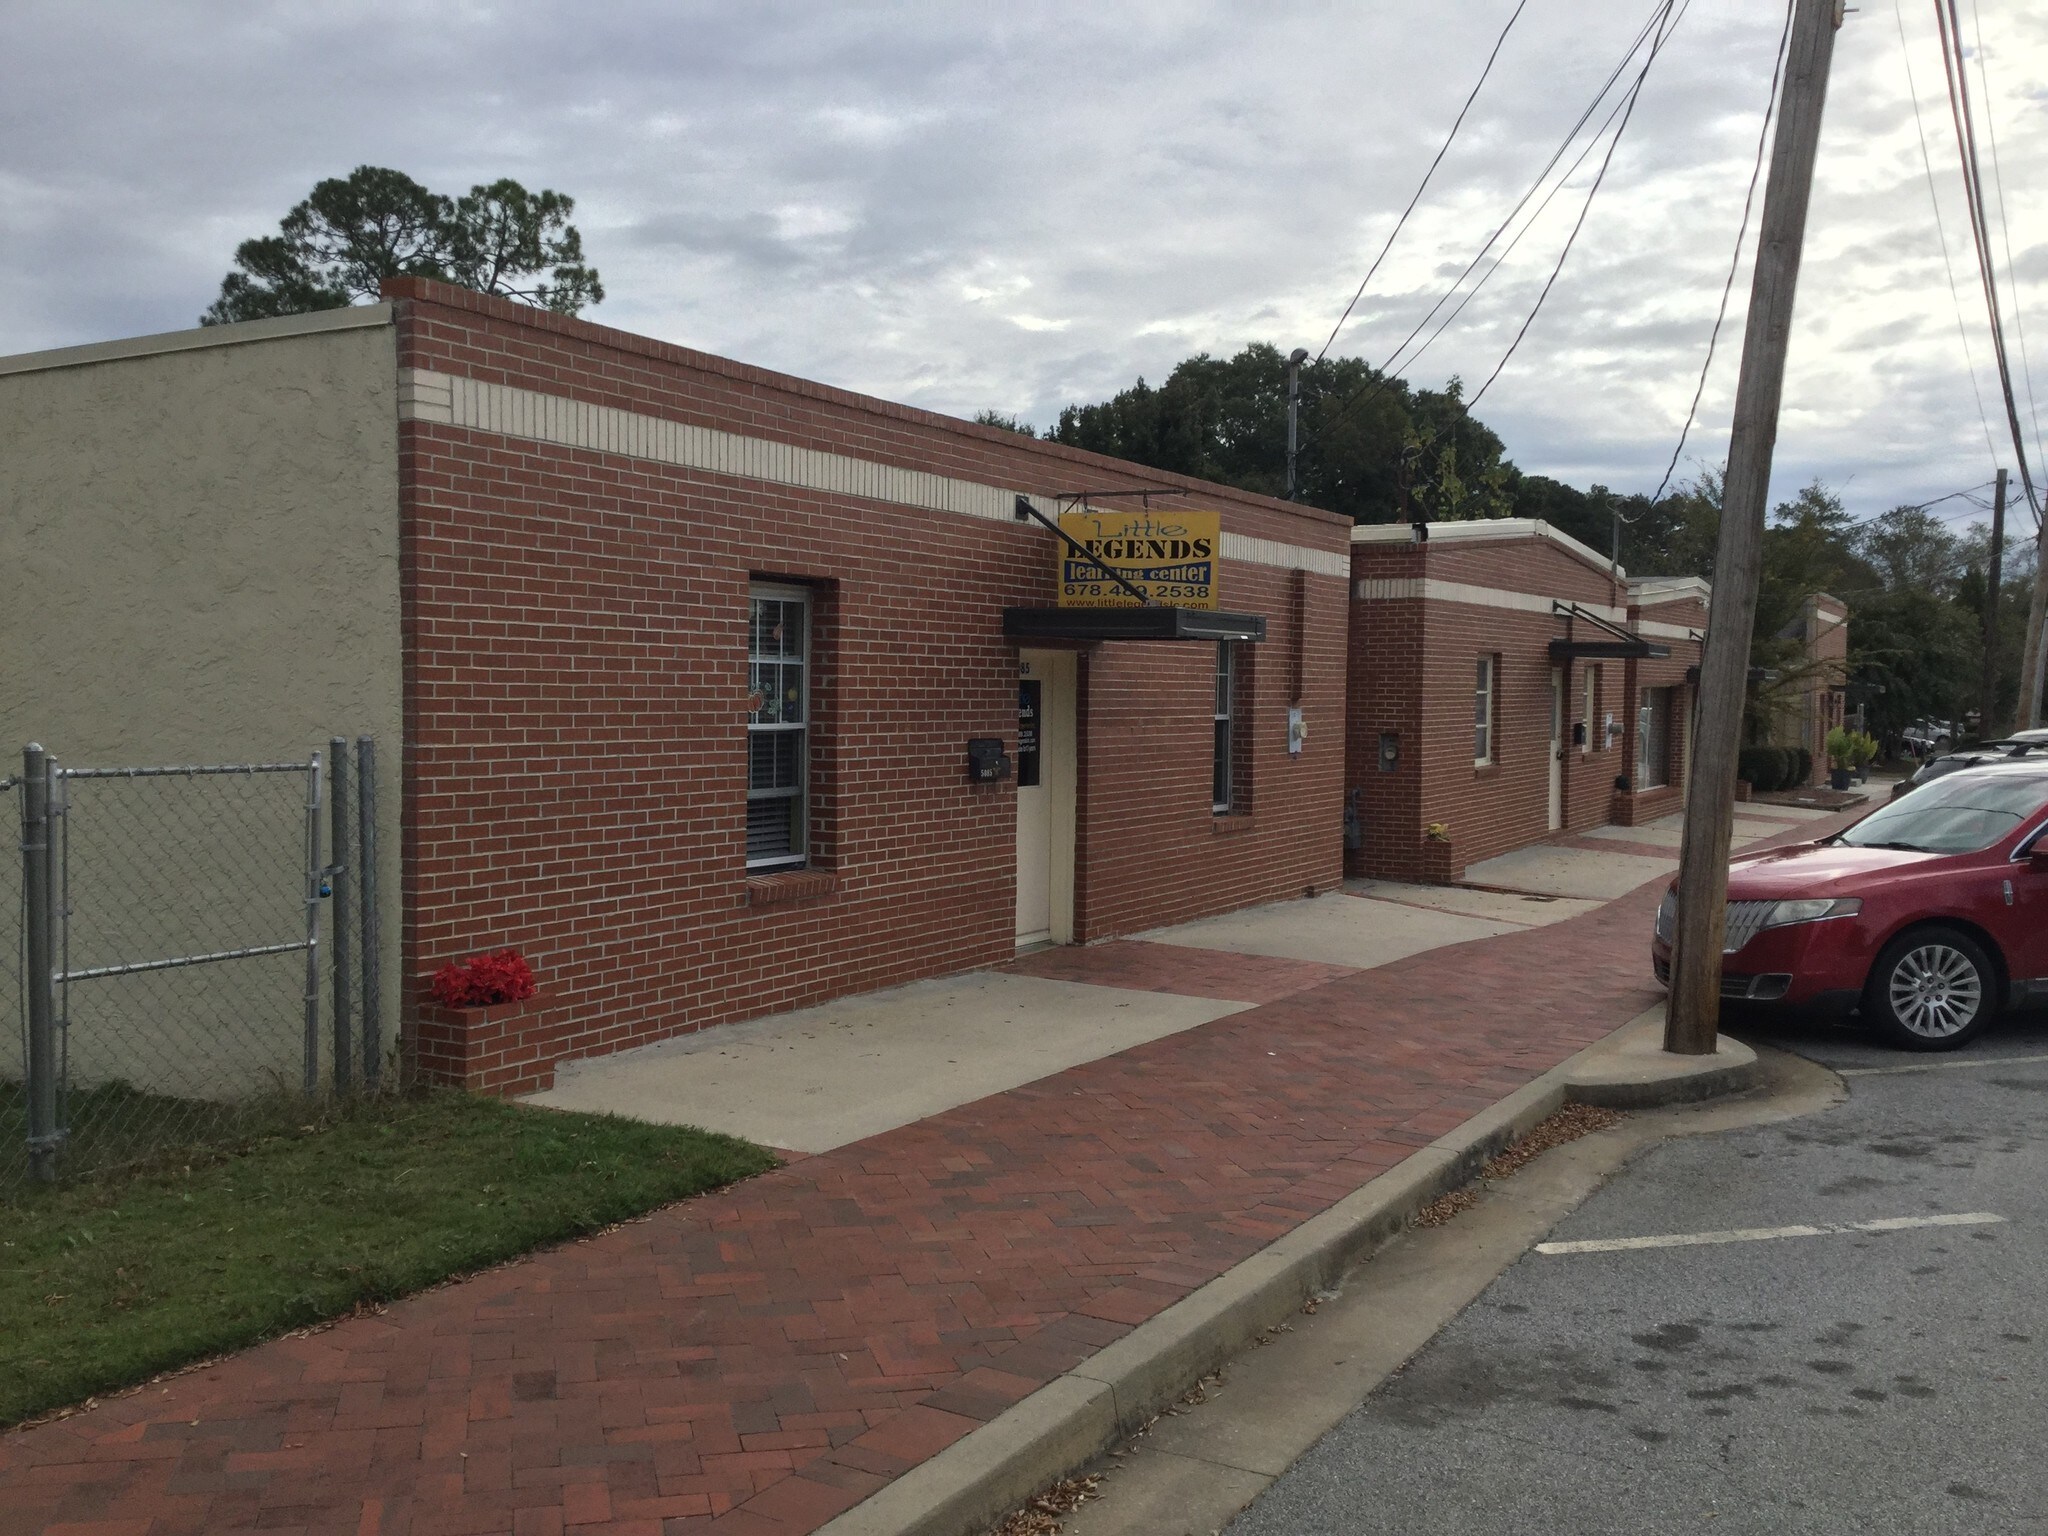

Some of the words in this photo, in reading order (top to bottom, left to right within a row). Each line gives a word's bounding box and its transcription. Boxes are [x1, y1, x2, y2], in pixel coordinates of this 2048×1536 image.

[1092, 520, 1188, 537] Little
[1066, 538, 1211, 559] LEGENDS
[1070, 563, 1144, 580] learing
[1149, 566, 1207, 582] center
